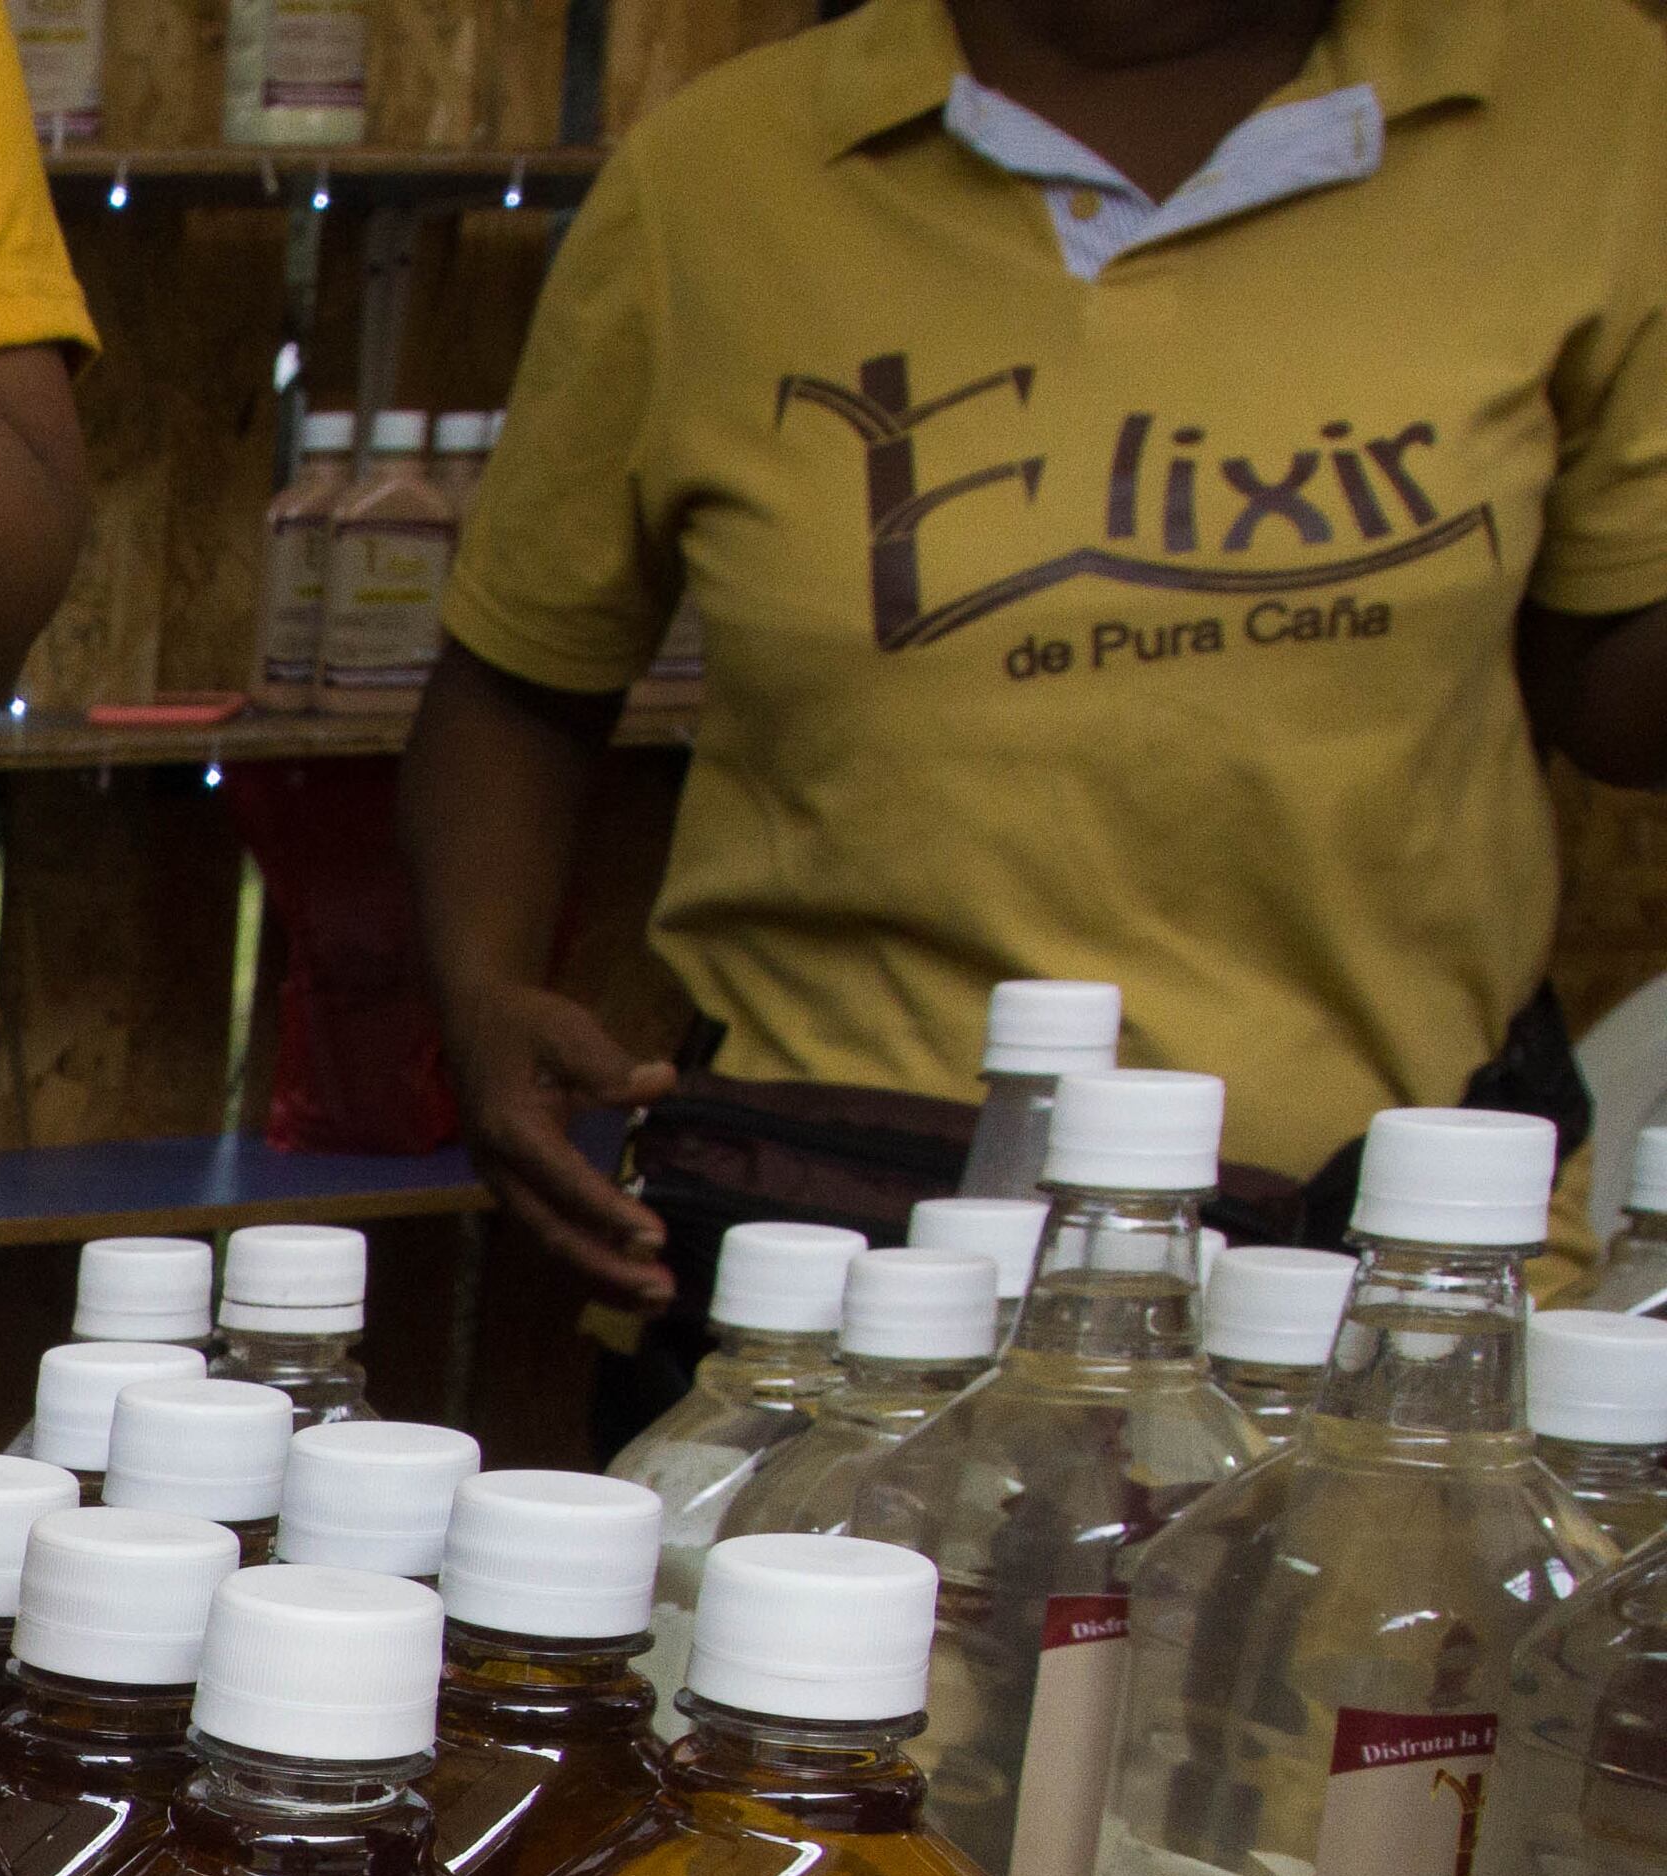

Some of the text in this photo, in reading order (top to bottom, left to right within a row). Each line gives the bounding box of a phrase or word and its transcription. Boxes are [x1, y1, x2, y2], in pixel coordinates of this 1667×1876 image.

[775, 353, 1503, 652] Elixir
[1007, 597, 1392, 681] de Pura Caña
[1361, 1735, 1454, 1763] Disfruta
